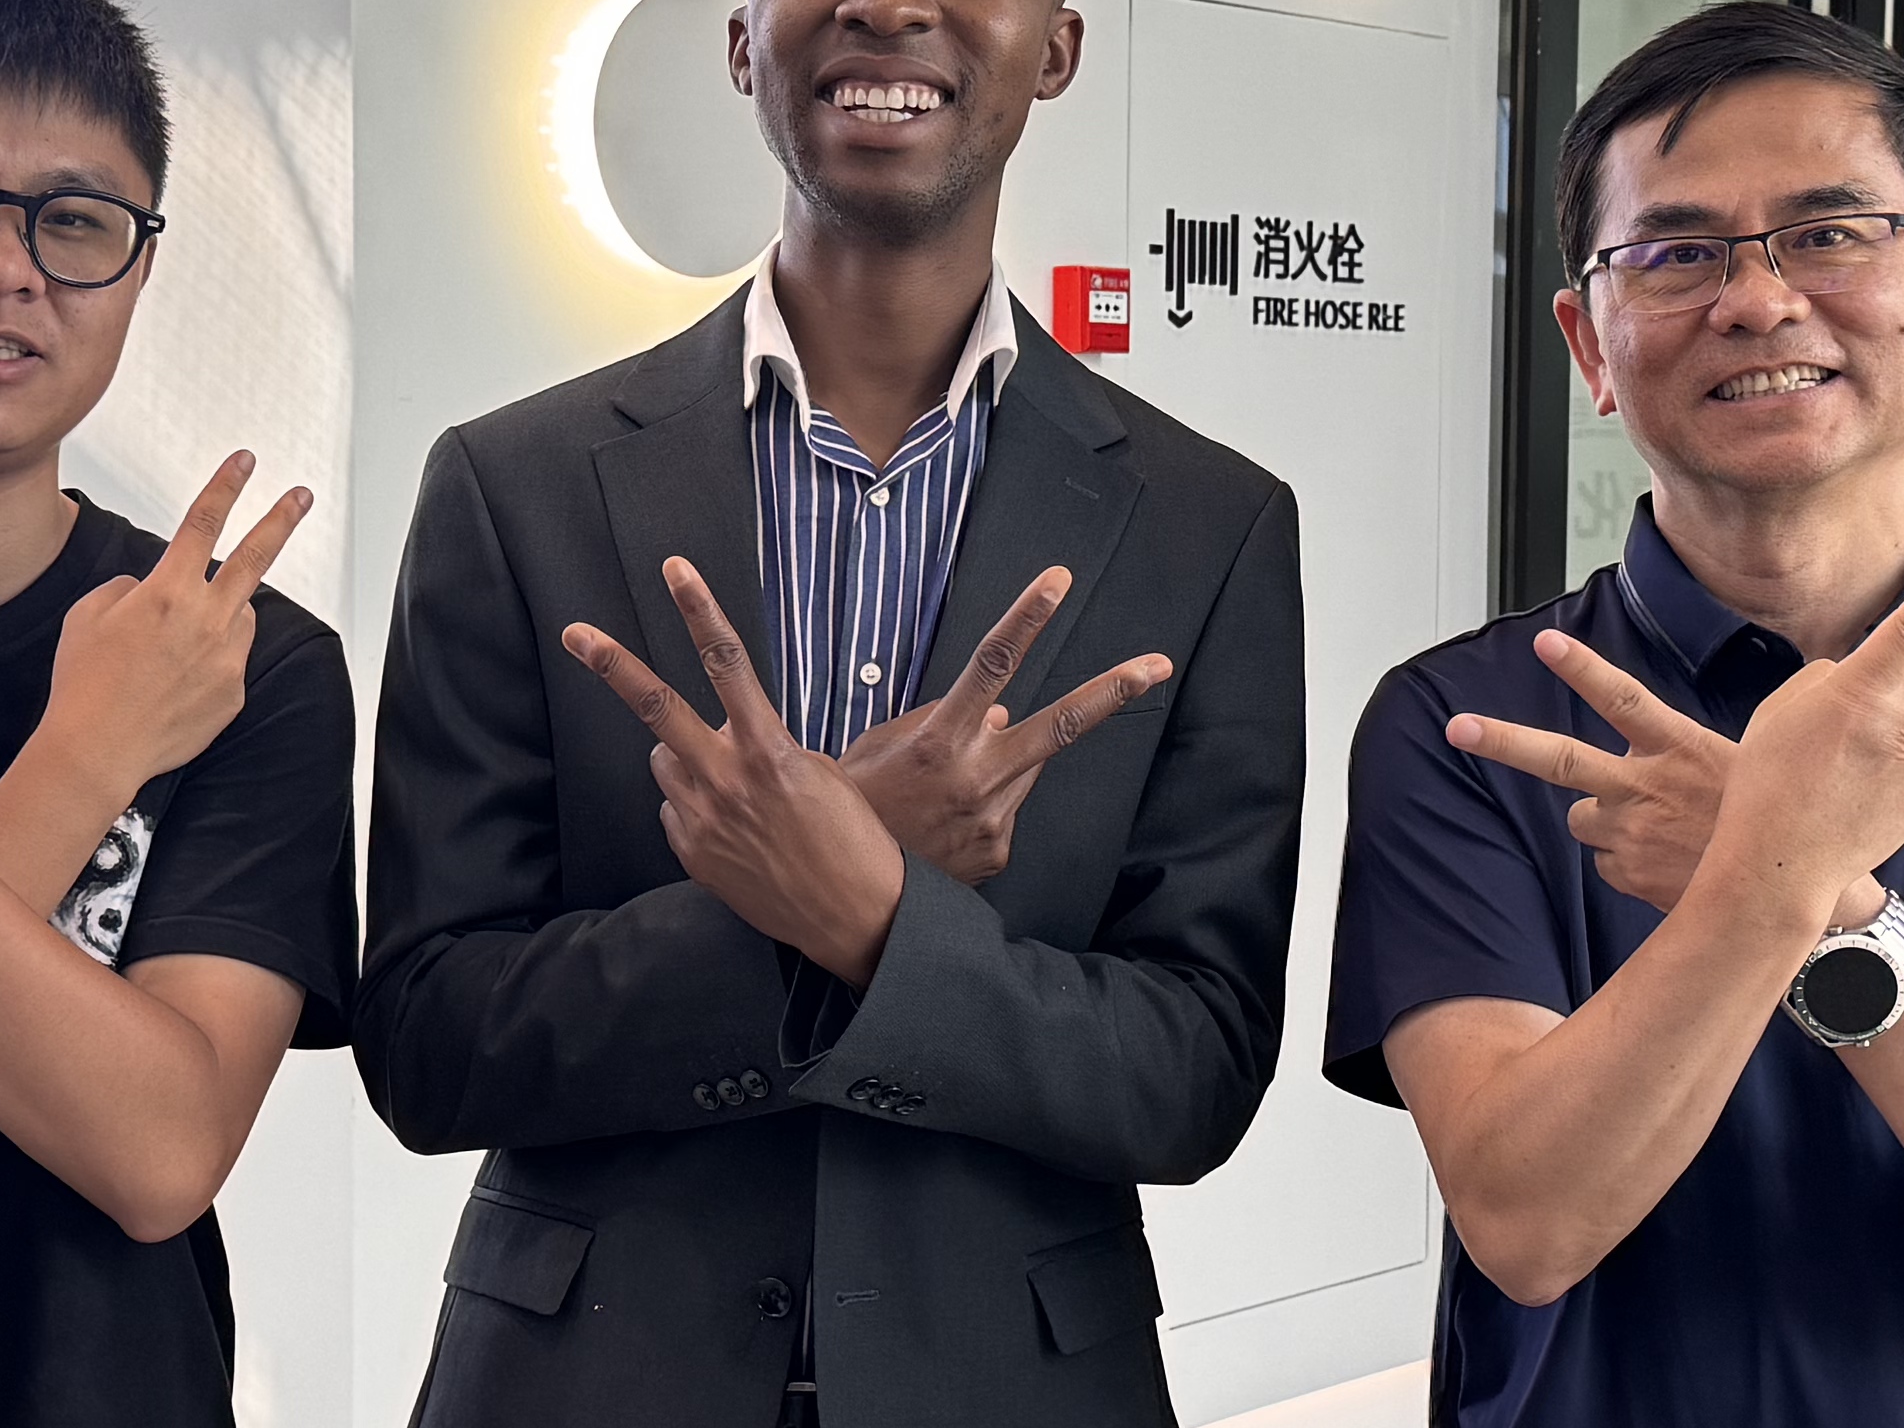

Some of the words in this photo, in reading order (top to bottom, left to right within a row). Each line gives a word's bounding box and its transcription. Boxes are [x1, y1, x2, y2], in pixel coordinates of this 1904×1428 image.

[1252, 215, 1366, 285] 消火栓
[1252, 296, 1300, 327] FIRE
[1303, 299, 1364, 331] HOSE
